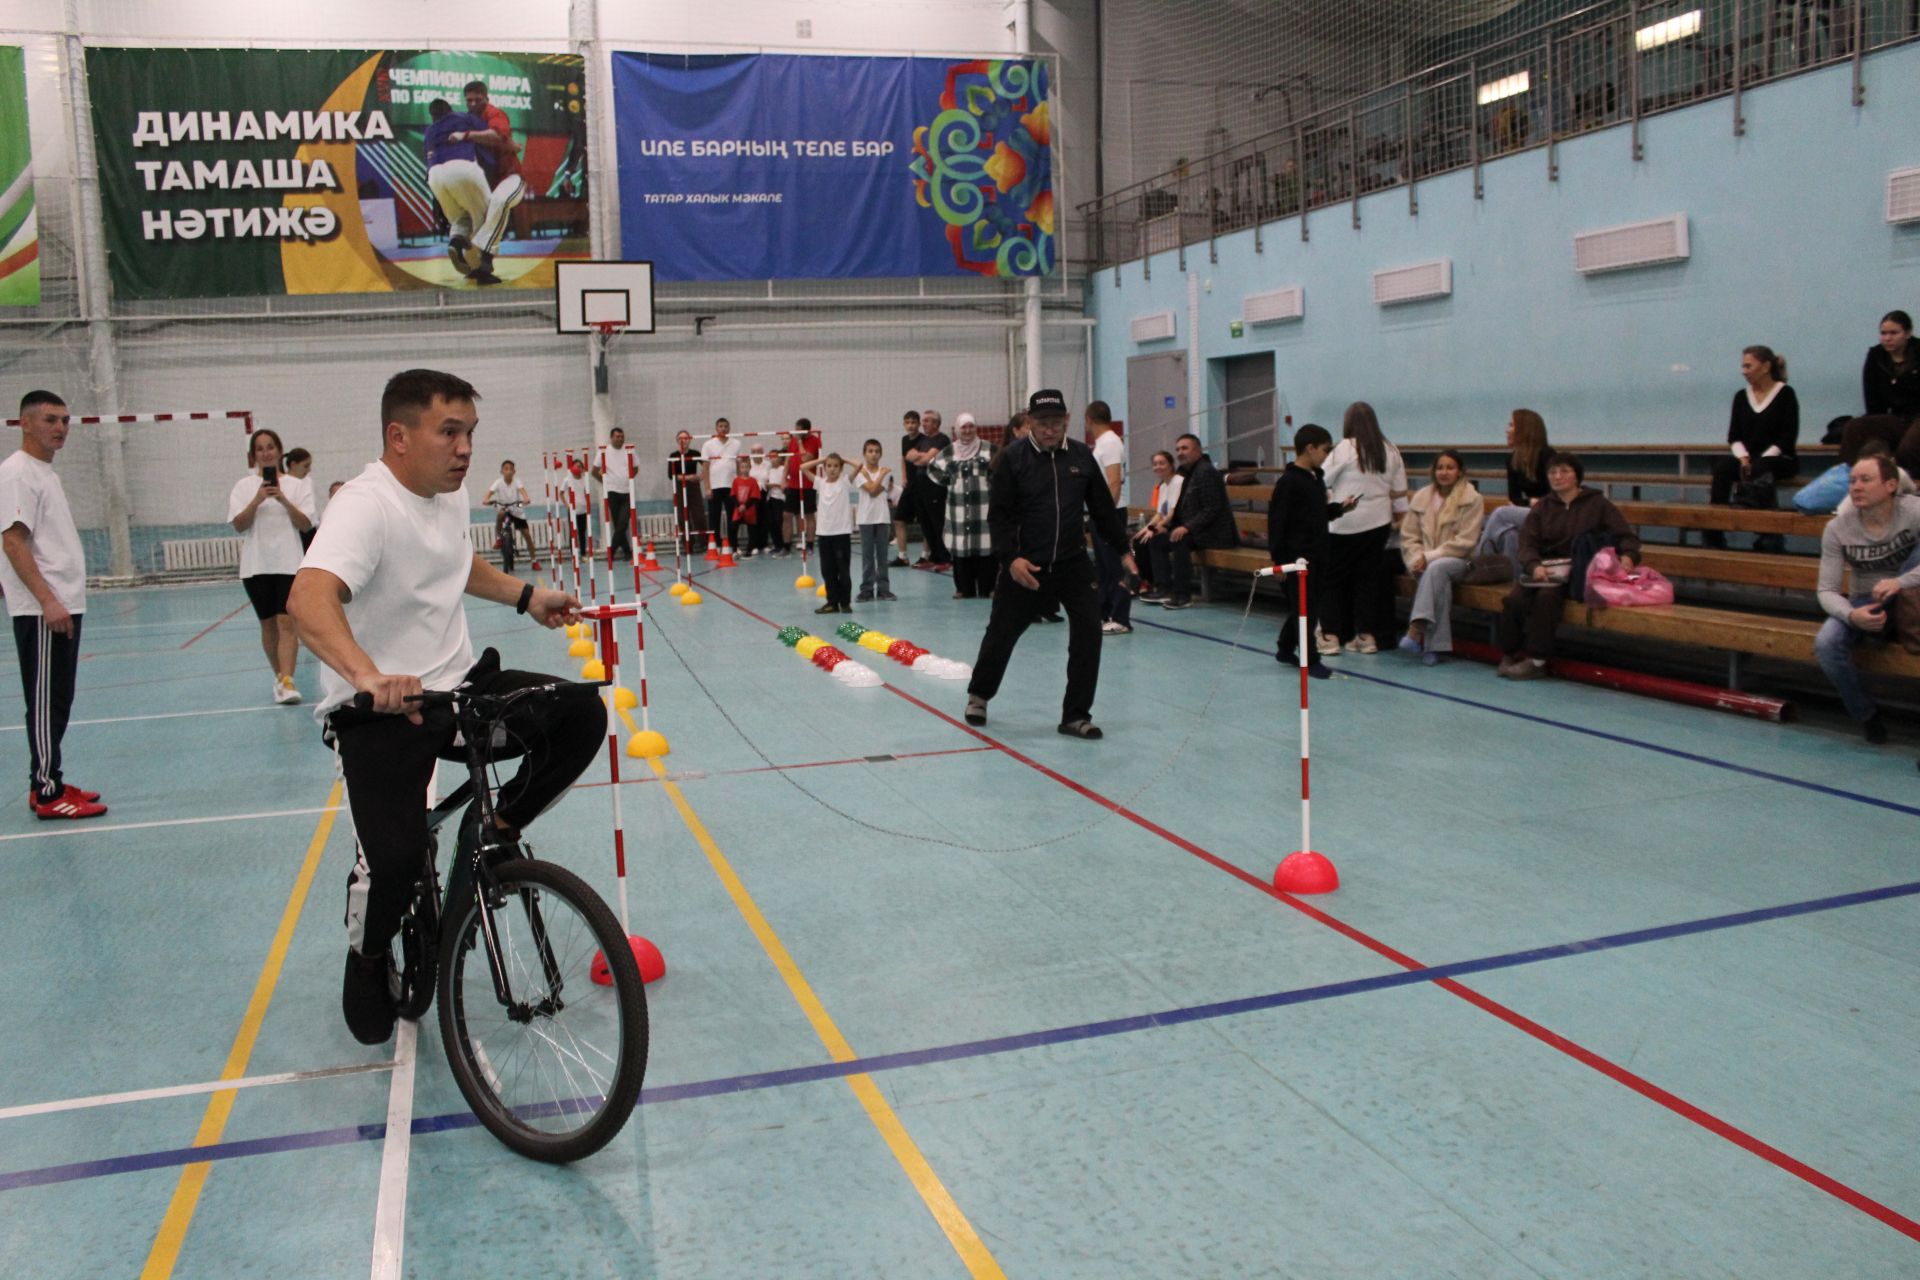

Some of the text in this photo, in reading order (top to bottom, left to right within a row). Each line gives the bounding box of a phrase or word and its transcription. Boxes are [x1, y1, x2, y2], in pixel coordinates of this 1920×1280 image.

[489, 75, 532, 93] МИРА
[391, 89, 410, 104] ПО
[488, 94, 532, 109] ОЯСАХ
[132, 110, 394, 147] ДИНАМИКА
[640, 140, 894, 159] ИЛЕ БАРНЫҢ ТЕЛЕ БАР
[135, 159, 337, 191] ТАМАША
[643, 193, 783, 204] ТАТАР ХАЛЫК МӘКАЛЕ
[142, 206, 336, 240] НӘТИҖӘ
